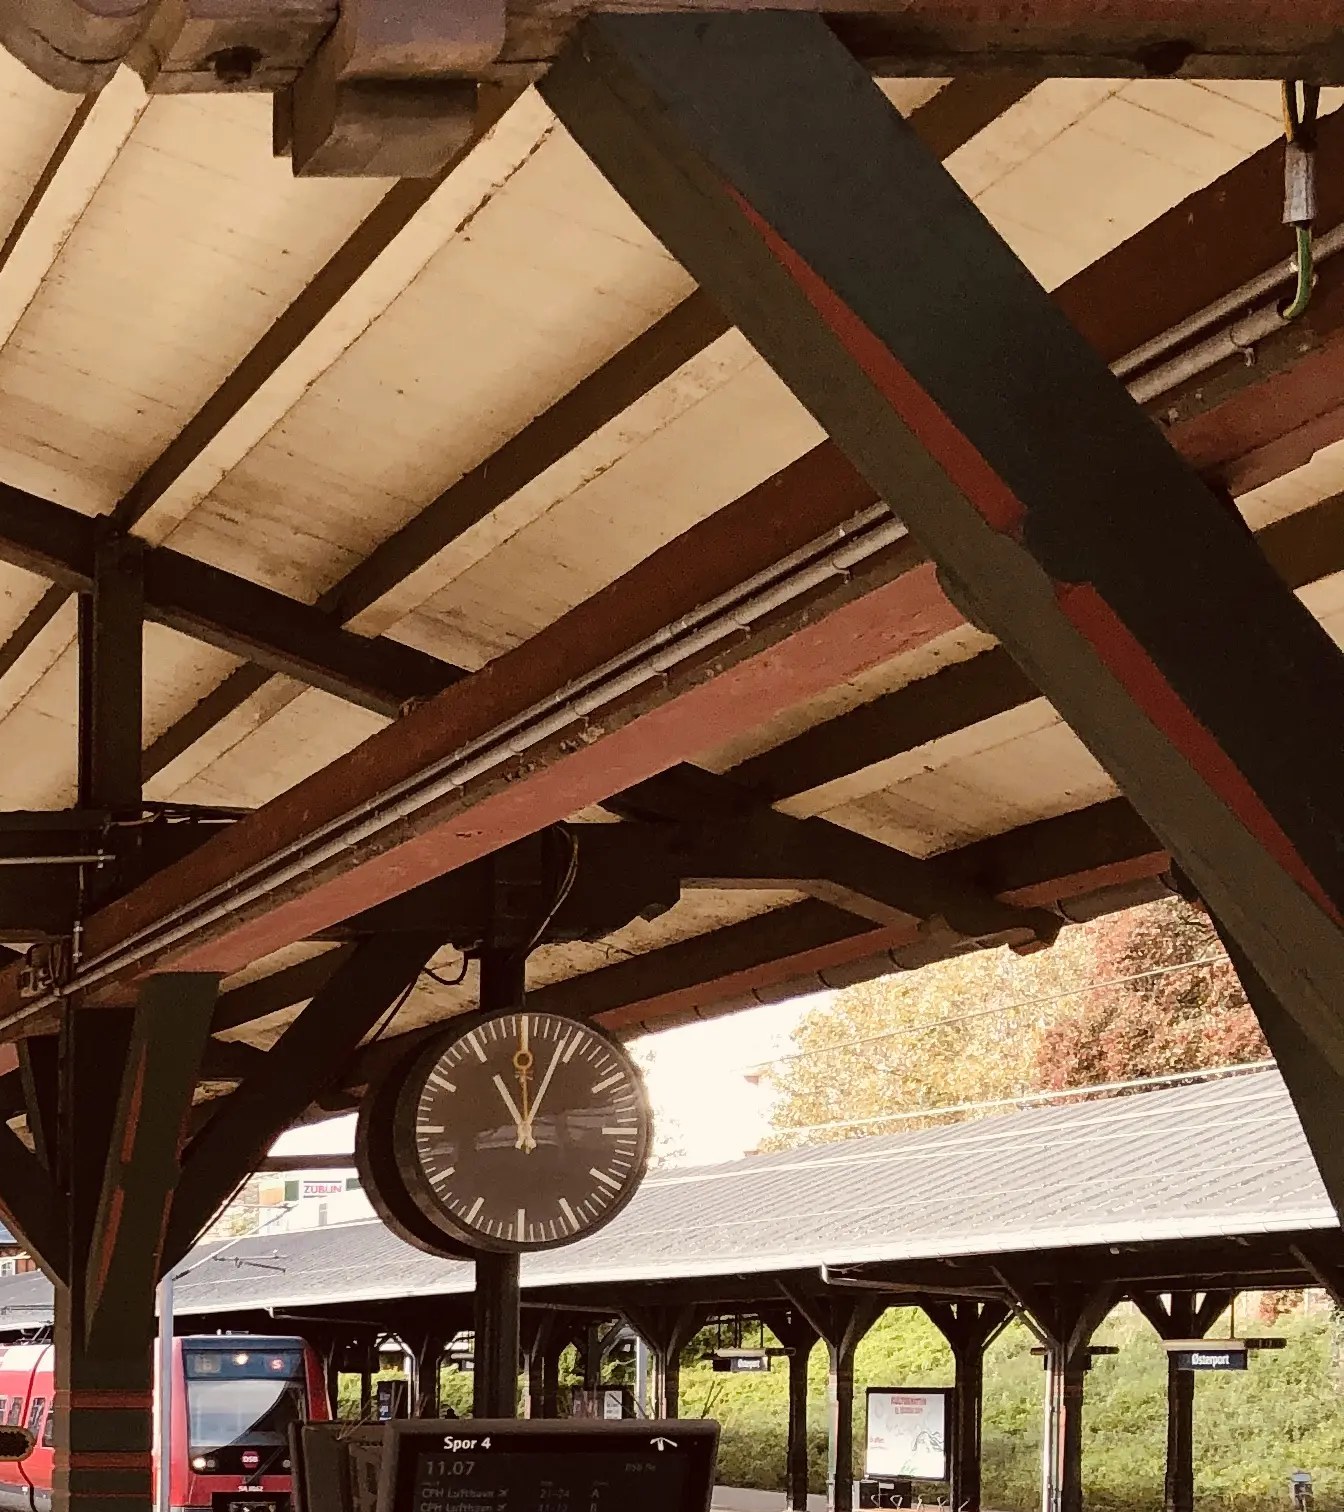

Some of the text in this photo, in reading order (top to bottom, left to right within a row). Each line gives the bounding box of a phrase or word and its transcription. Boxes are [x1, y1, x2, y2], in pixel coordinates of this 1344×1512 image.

[1192, 1353, 1230, 1368] Østerport
[444, 1436, 491, 1452] Spor 4
[425, 1461, 475, 1476] 11.07
